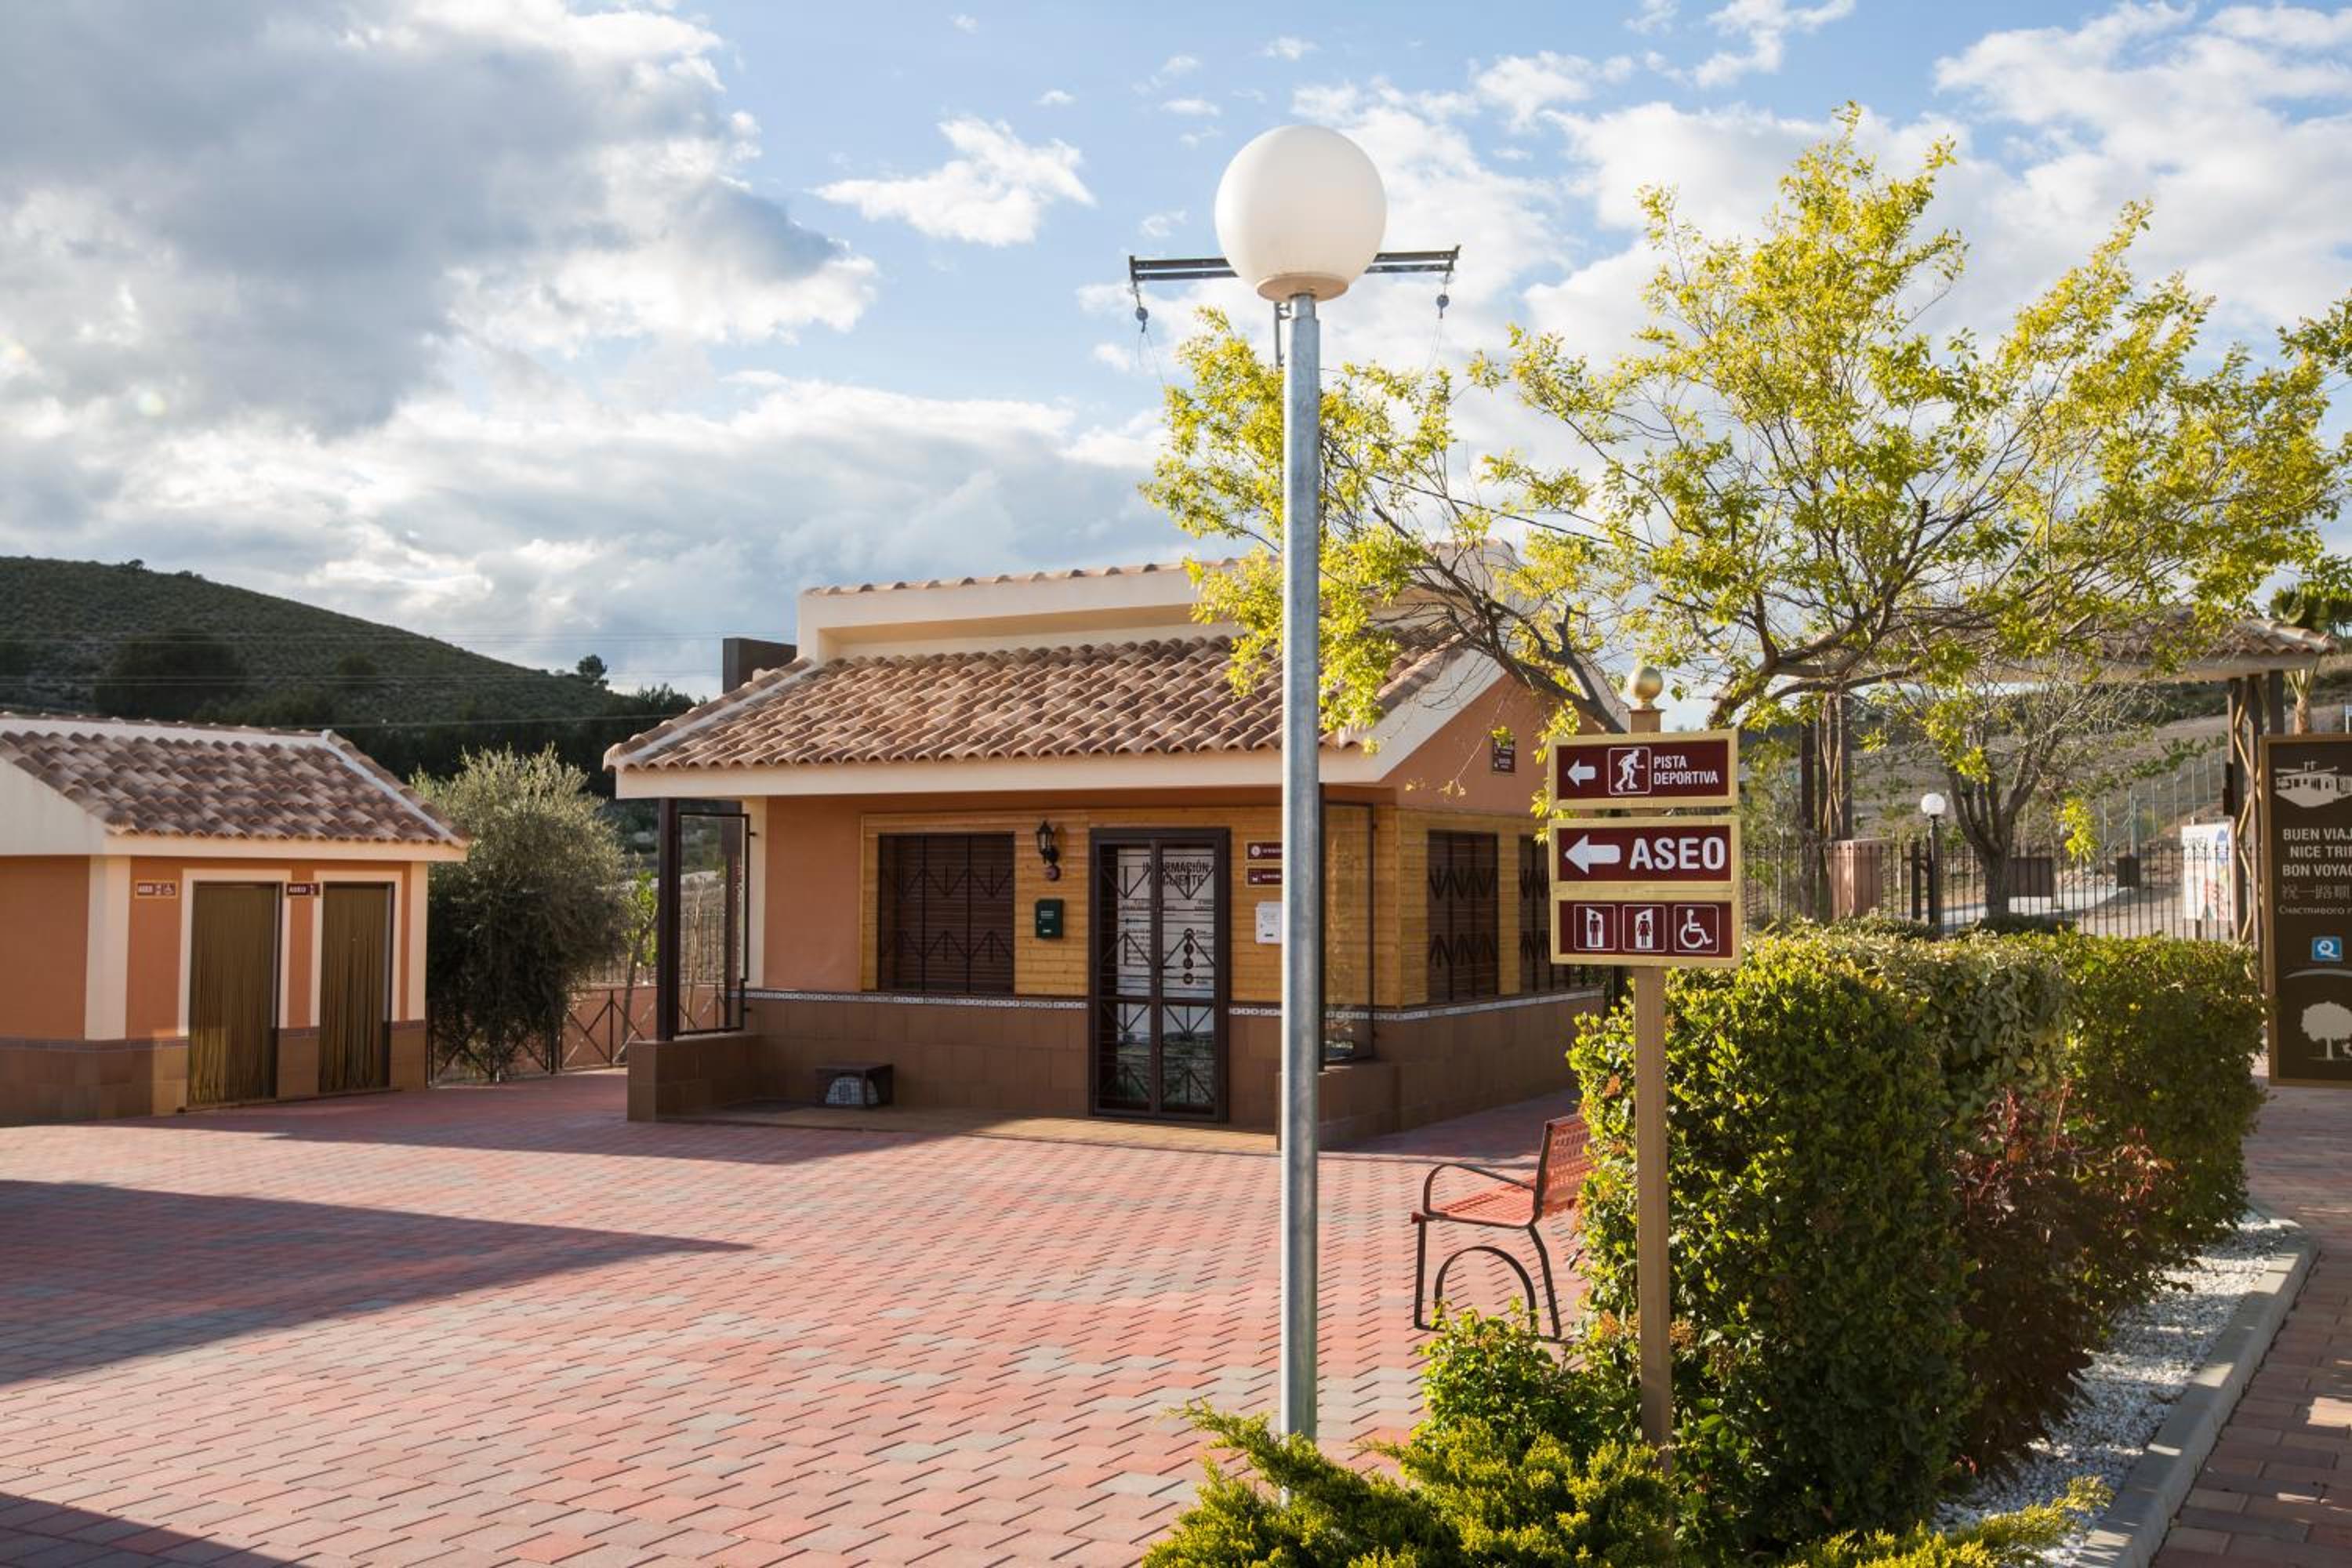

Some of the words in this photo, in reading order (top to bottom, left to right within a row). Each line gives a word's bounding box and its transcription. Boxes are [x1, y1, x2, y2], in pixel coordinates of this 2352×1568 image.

[1653, 755, 1687, 768] PISTA
[1653, 770, 1719, 785] DEPORTIVA
[2282, 828, 2320, 841] BUEN
[1629, 837, 1725, 871] ASEO
[2290, 845, 2321, 858] NICE
[1142, 859, 1209, 873] INRMACIÓN
[2282, 864, 2310, 877] BON
